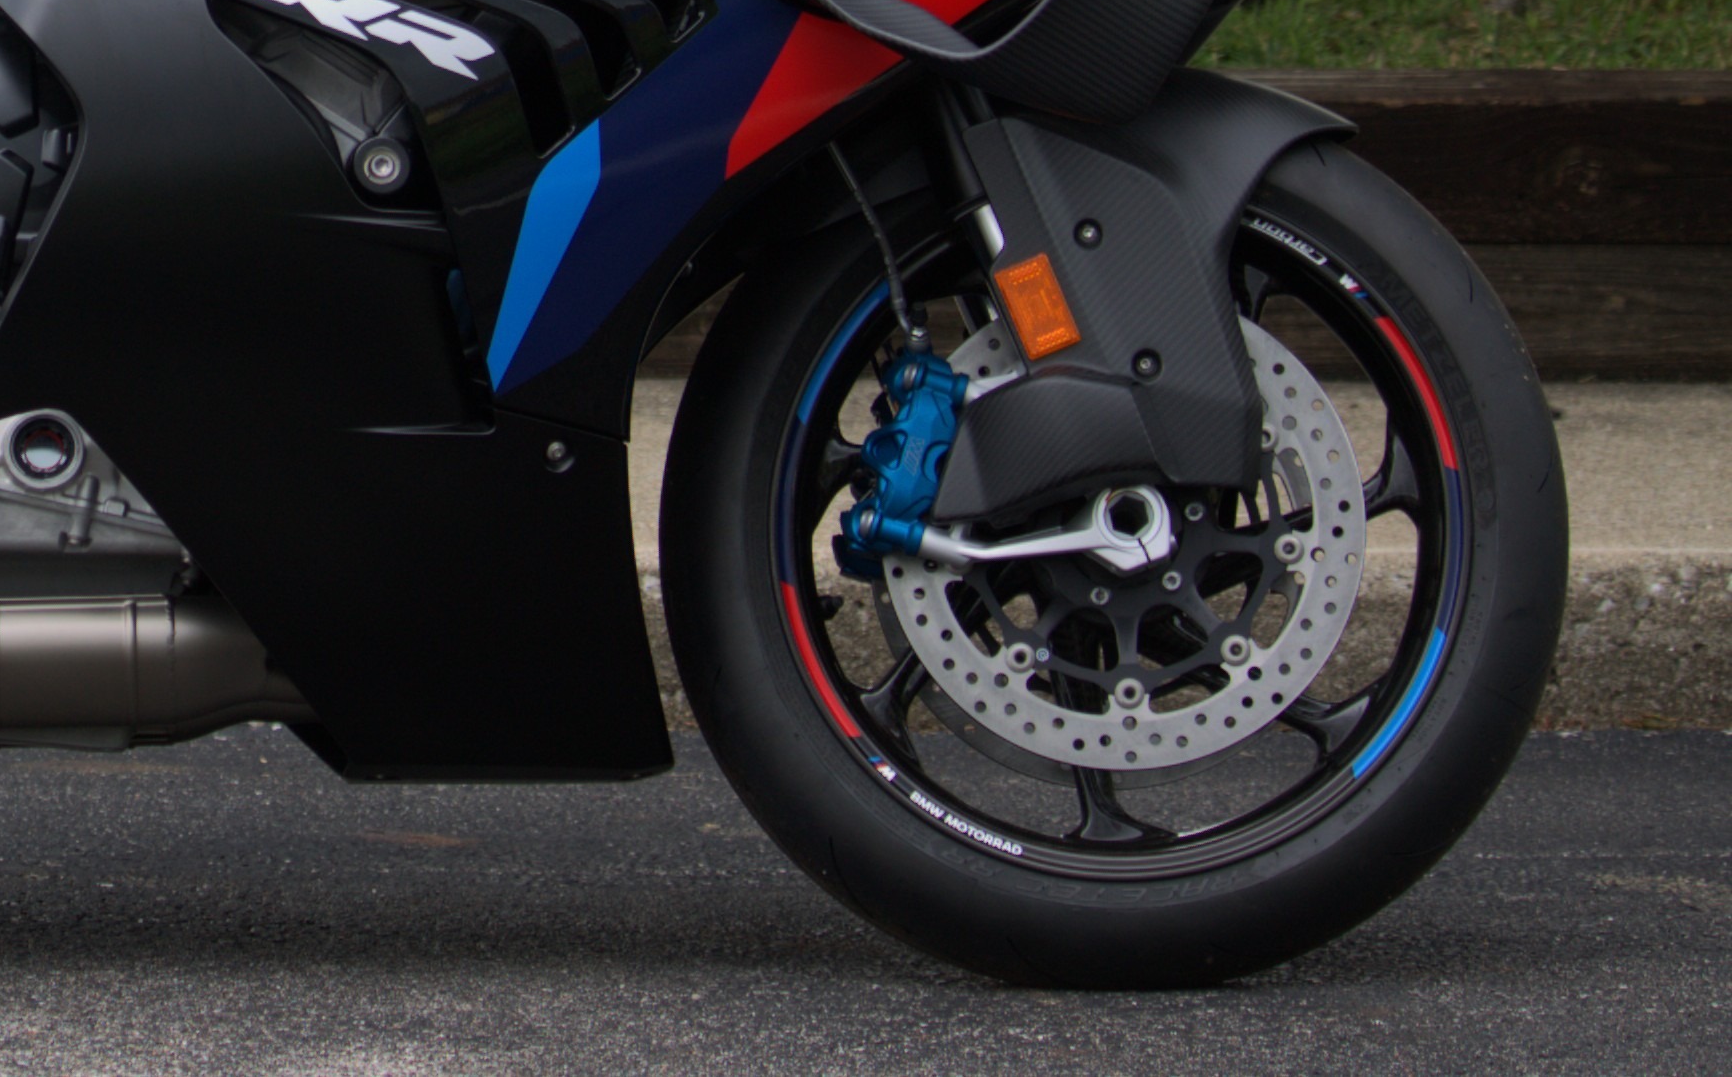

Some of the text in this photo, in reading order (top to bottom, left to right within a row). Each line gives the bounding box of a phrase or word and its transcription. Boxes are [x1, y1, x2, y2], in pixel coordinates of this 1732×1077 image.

[1249, 218, 1327, 265] Carbon
[909, 790, 1023, 856] BMW MOTORRAD
